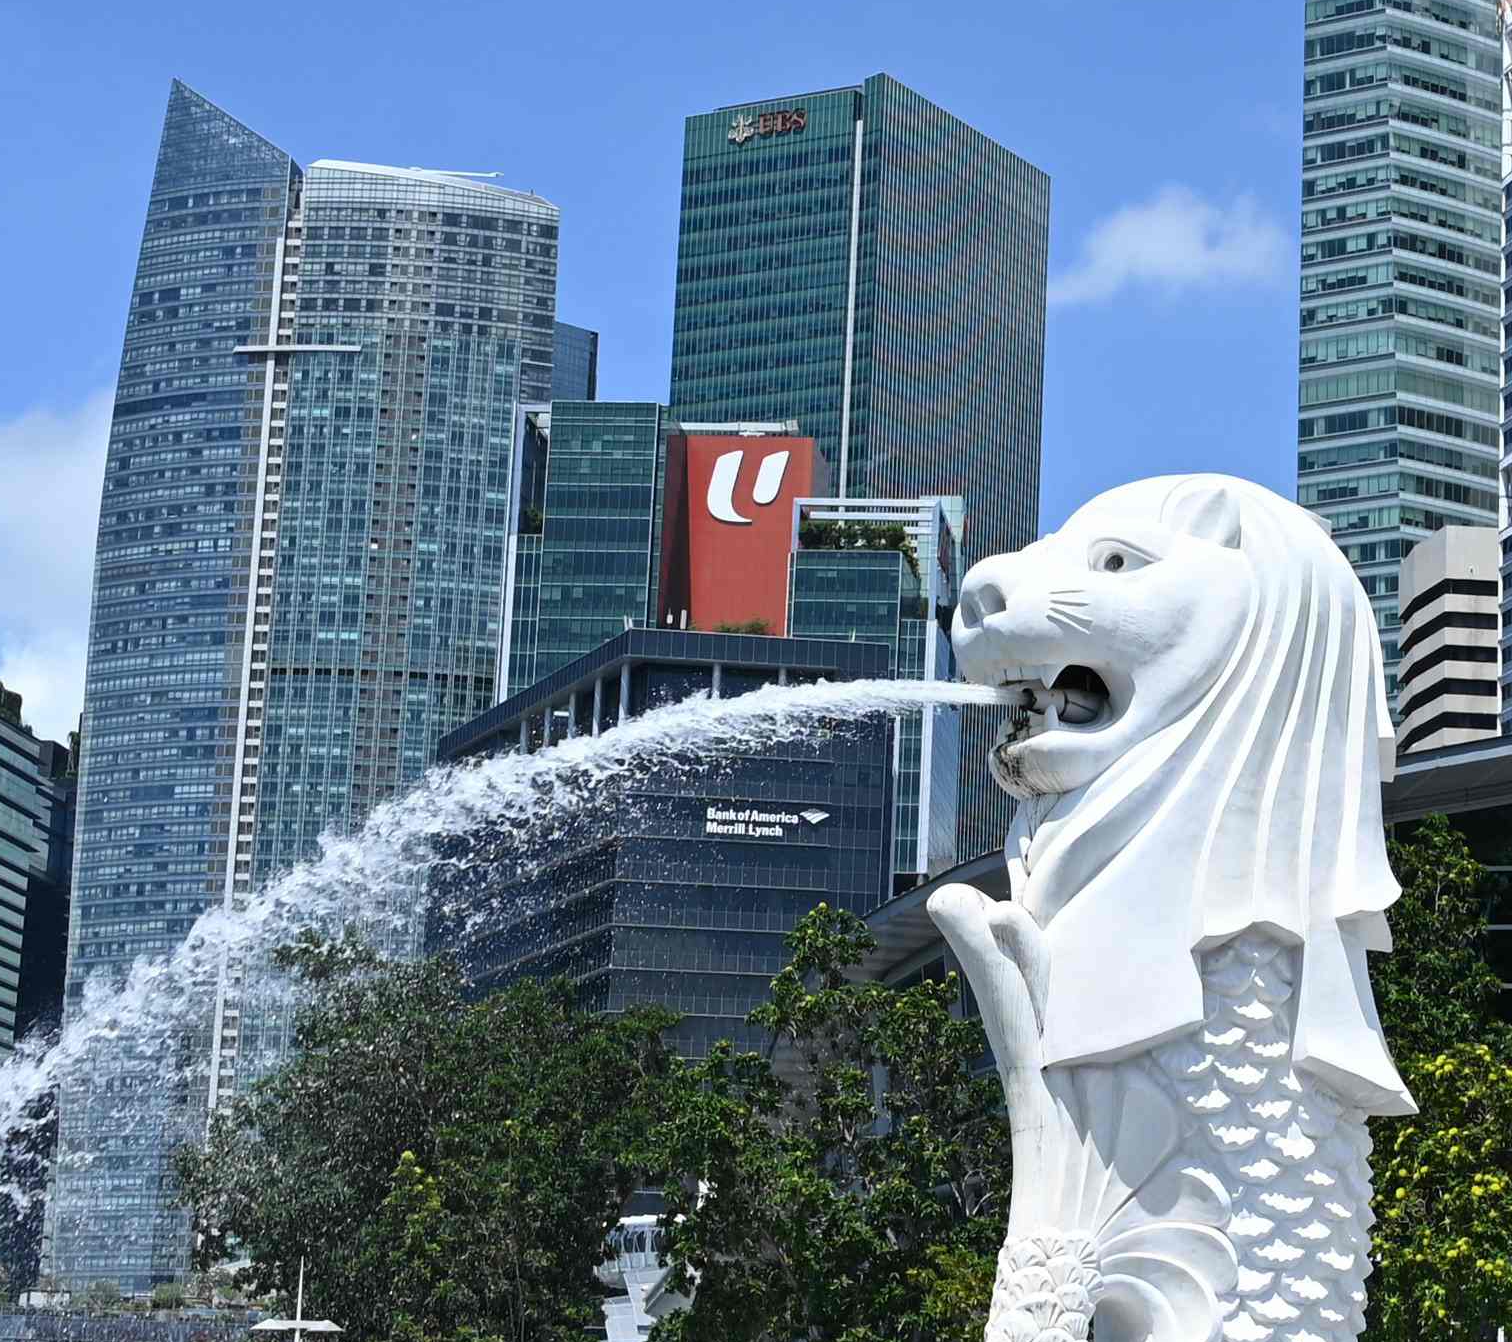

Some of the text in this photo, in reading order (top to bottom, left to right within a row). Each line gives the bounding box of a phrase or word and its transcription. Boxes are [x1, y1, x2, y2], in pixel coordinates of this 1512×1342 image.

[759, 109, 806, 133] UBS
[707, 807, 799, 824] Bank of America
[706, 821, 783, 837] Merrill Lynch
